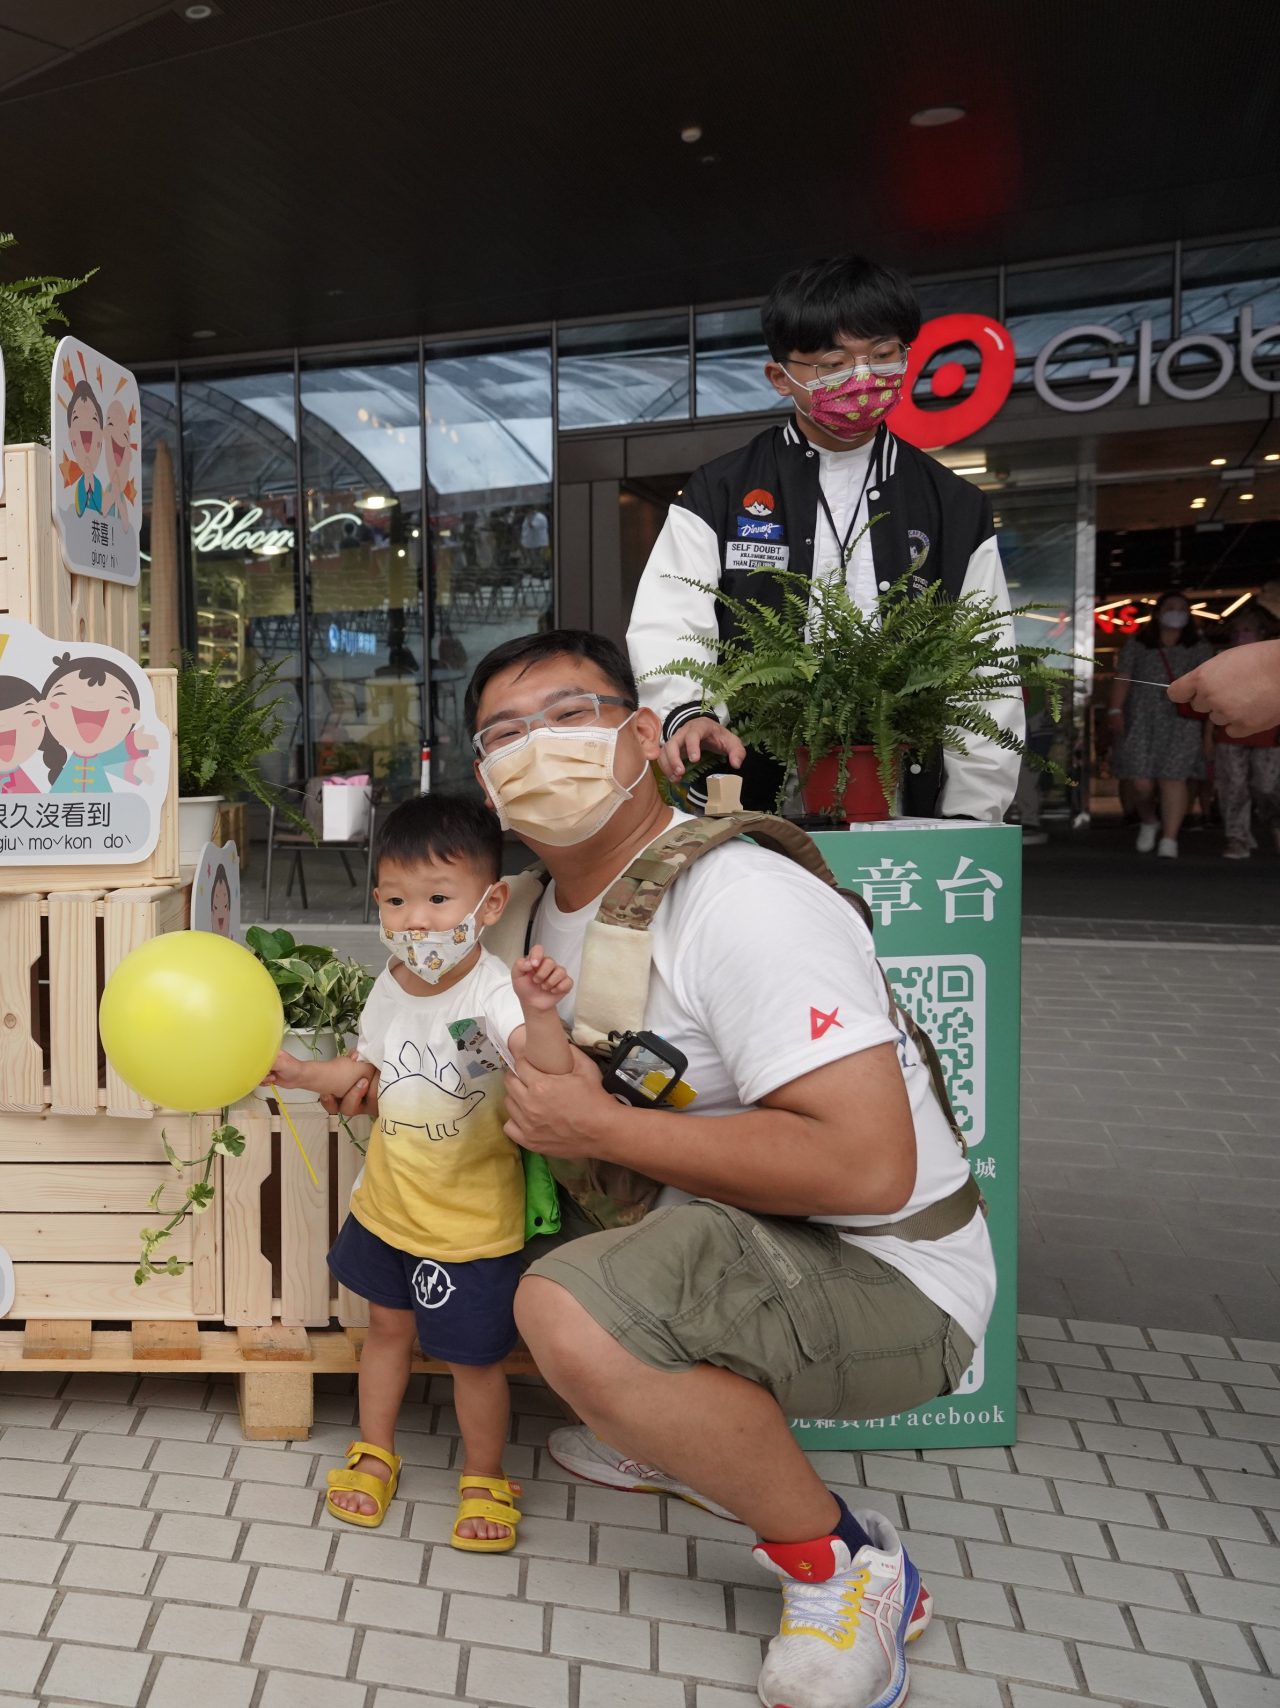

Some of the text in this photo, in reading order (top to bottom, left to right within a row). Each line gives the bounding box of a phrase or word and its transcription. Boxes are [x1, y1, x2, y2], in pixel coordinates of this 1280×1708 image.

[731, 543, 782, 555] SELF DOUBT
[851, 855, 1004, 927] 章台
